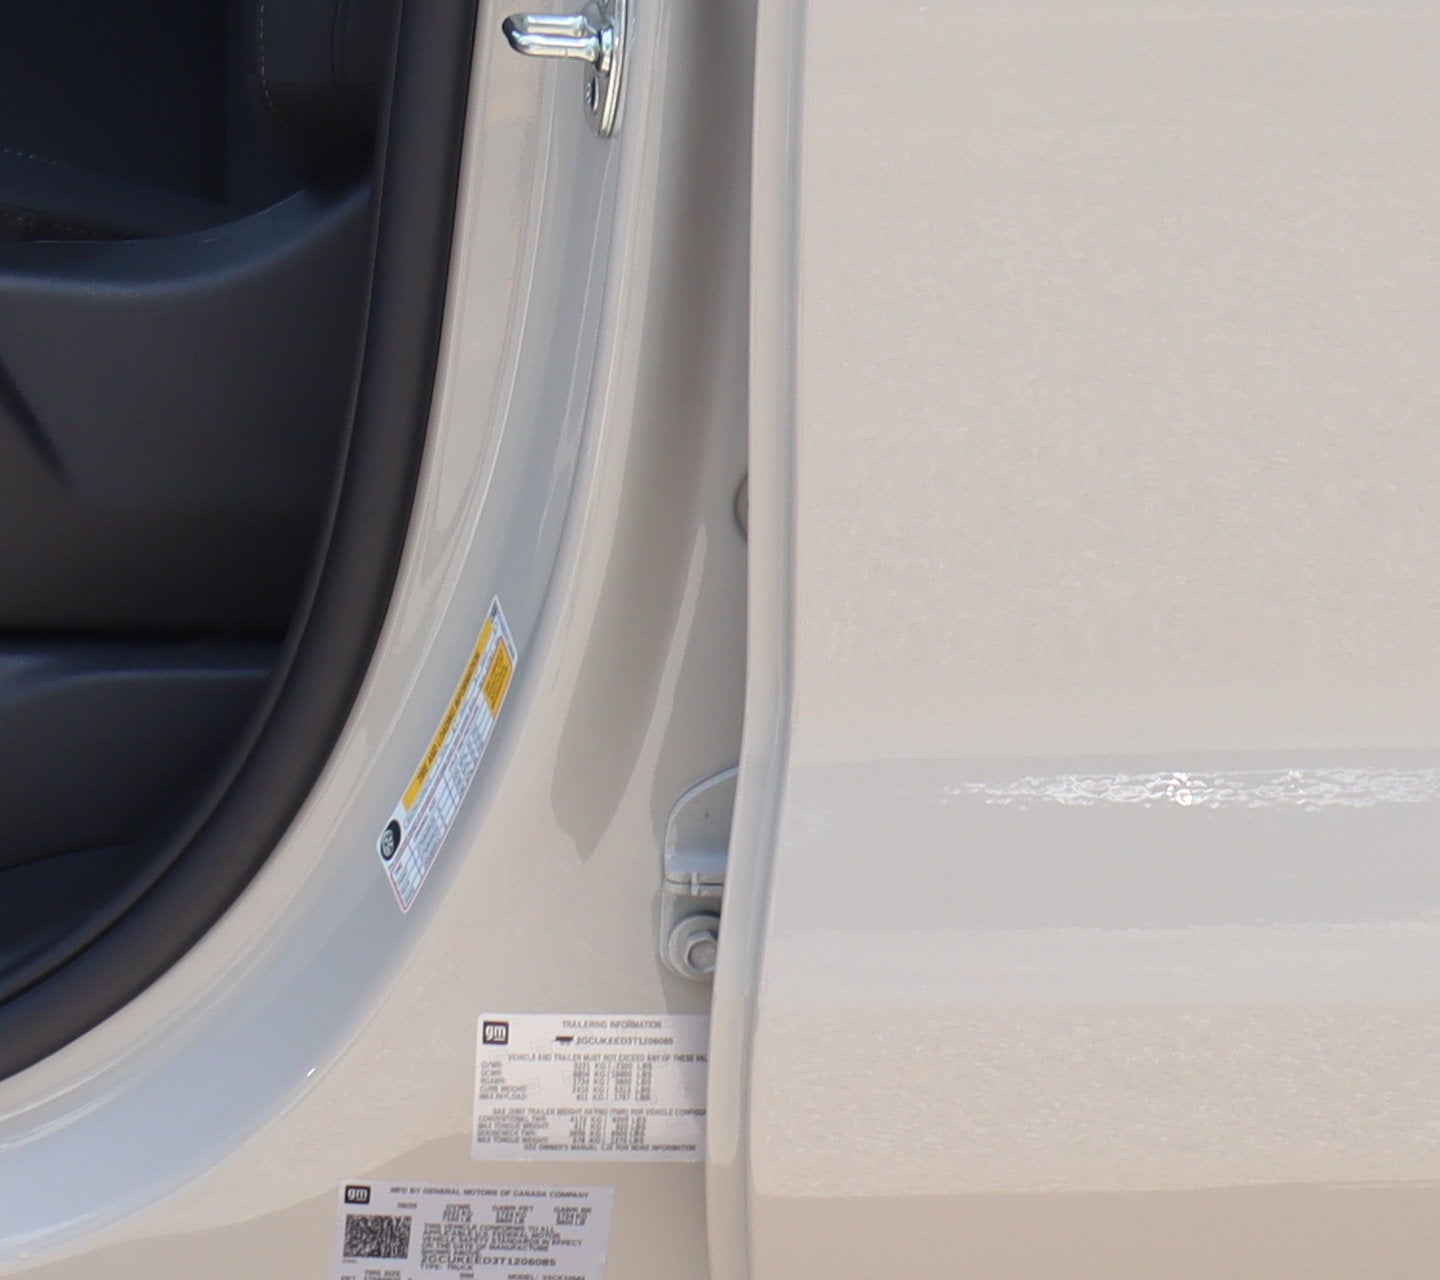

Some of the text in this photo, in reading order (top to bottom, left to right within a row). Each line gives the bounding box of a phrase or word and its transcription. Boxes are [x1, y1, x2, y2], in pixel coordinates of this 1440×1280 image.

[609, 1020, 662, 1029] INFORMATION
[422, 1187, 461, 1196] GENERAL
[463, 1188, 497, 1197] MOTORS
[500, 1189, 511, 1197] OF
[513, 1189, 547, 1198] CANADA
[549, 1190, 590, 1199] COMPANY
